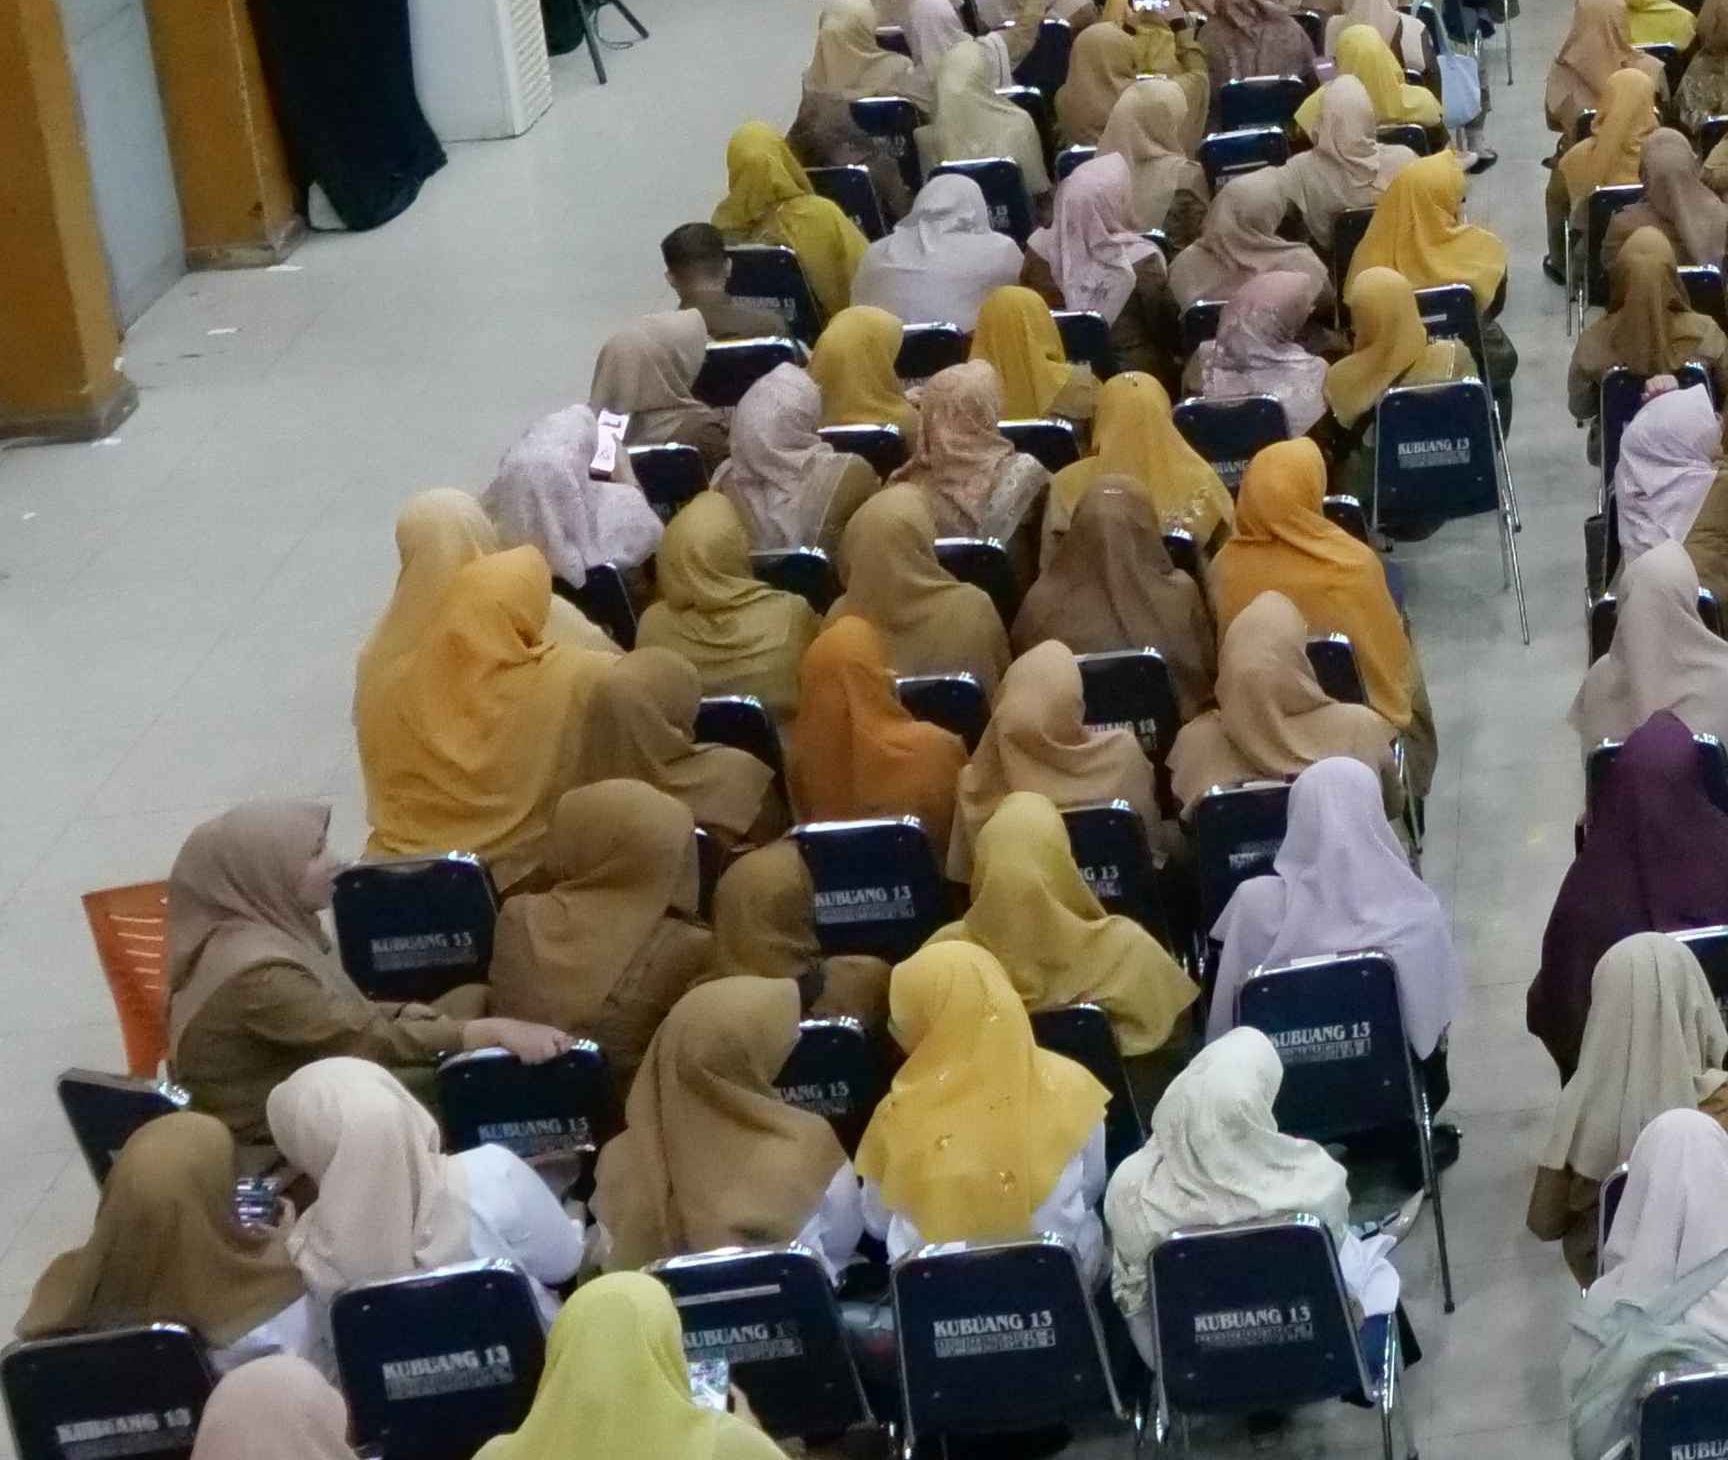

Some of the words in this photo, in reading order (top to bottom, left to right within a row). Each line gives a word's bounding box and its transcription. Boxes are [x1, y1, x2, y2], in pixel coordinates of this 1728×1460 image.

[1397, 438, 1452, 456] KUBUANG
[1456, 437, 1471, 452] 13
[1101, 865, 1120, 881] 13
[815, 886, 888, 908] KUBUANG
[893, 884, 913, 901] 13
[1352, 1021, 1371, 1039] 13
[829, 1081, 850, 1099] 13
[569, 1116, 590, 1133] 13
[933, 1313, 1024, 1339] KUBUANG
[1029, 1309, 1053, 1329] 13
[1194, 1308, 1283, 1333] KUBUANG
[1290, 1305, 1312, 1324] 13
